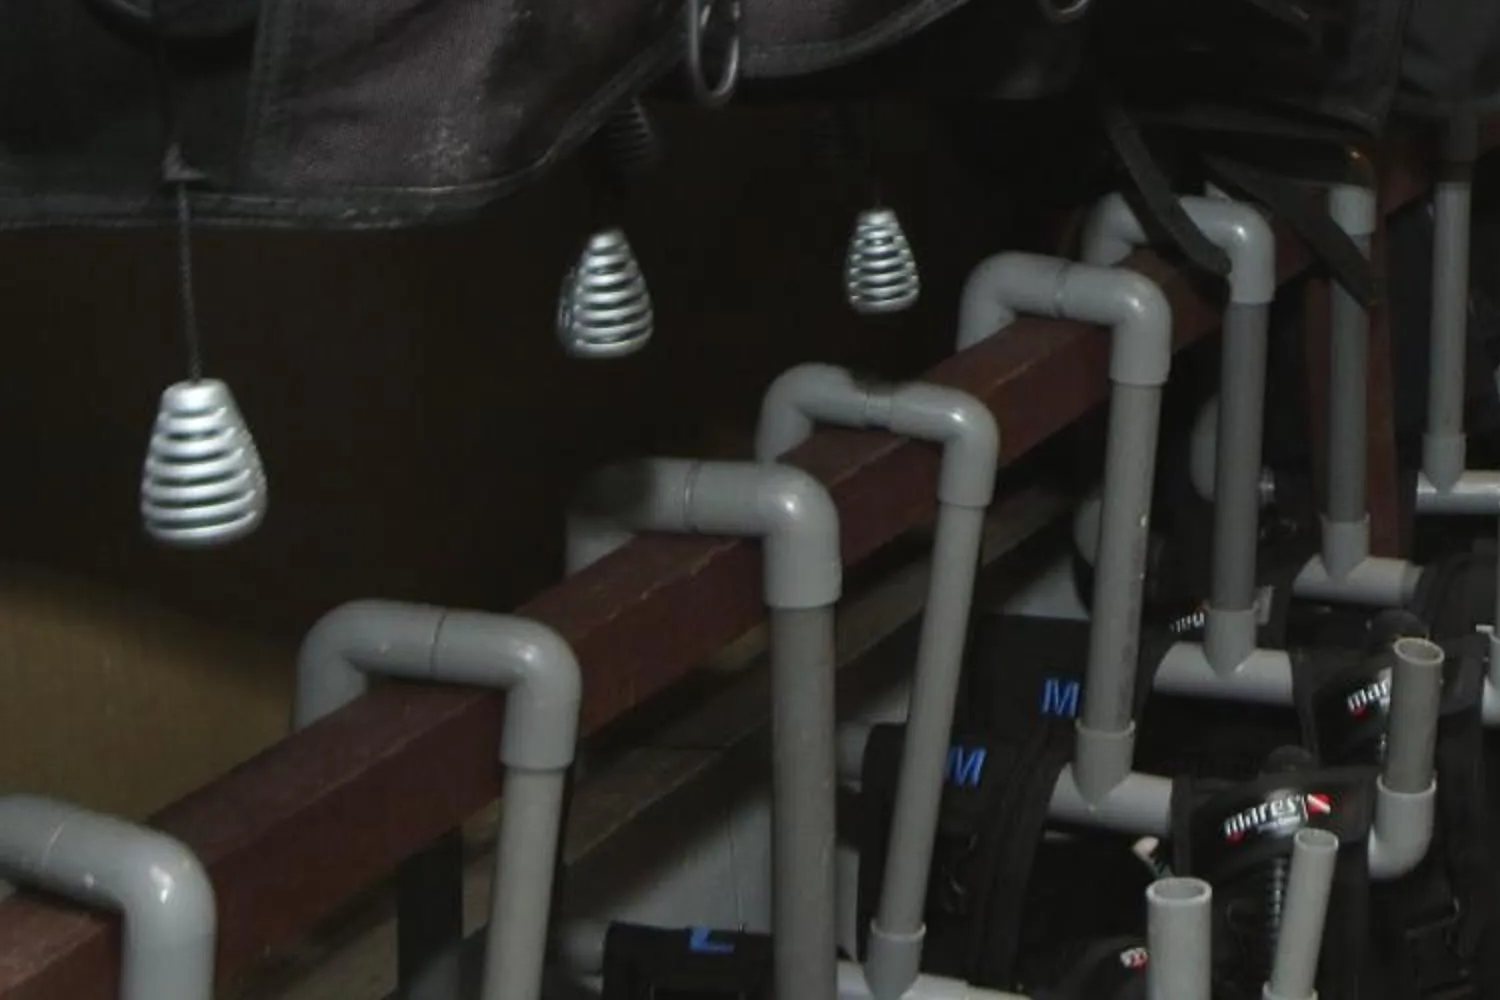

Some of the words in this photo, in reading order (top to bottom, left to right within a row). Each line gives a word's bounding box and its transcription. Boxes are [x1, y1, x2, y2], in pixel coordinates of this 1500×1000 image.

[1041, 677, 1080, 718] M
[948, 745, 988, 788] M
[1224, 796, 1299, 837] mares
